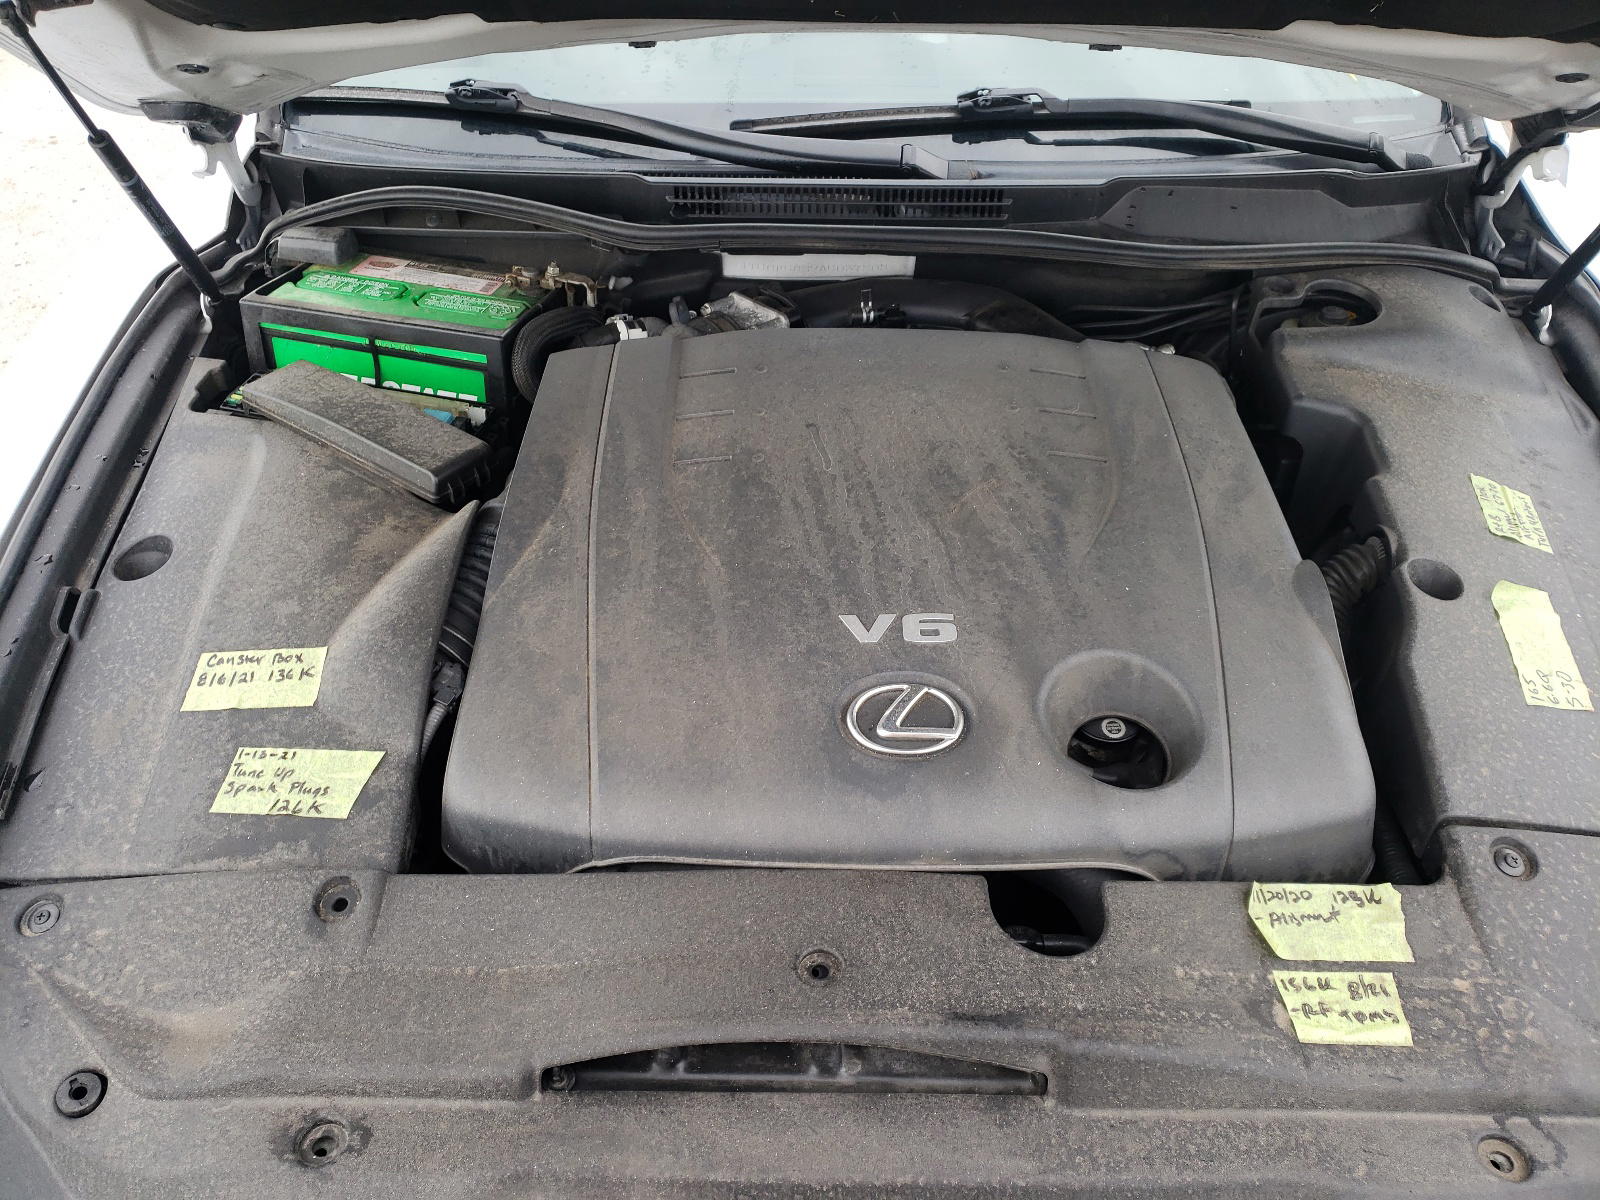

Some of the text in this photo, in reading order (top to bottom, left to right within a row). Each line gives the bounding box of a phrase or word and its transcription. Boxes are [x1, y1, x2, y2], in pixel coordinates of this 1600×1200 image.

[838, 613, 958, 643] V6
[271, 652, 304, 666] Box
[196, 671, 255, 688] 8/6/21
[232, 762, 265, 779] Tune
[224, 780, 331, 798] Spark Plugs
